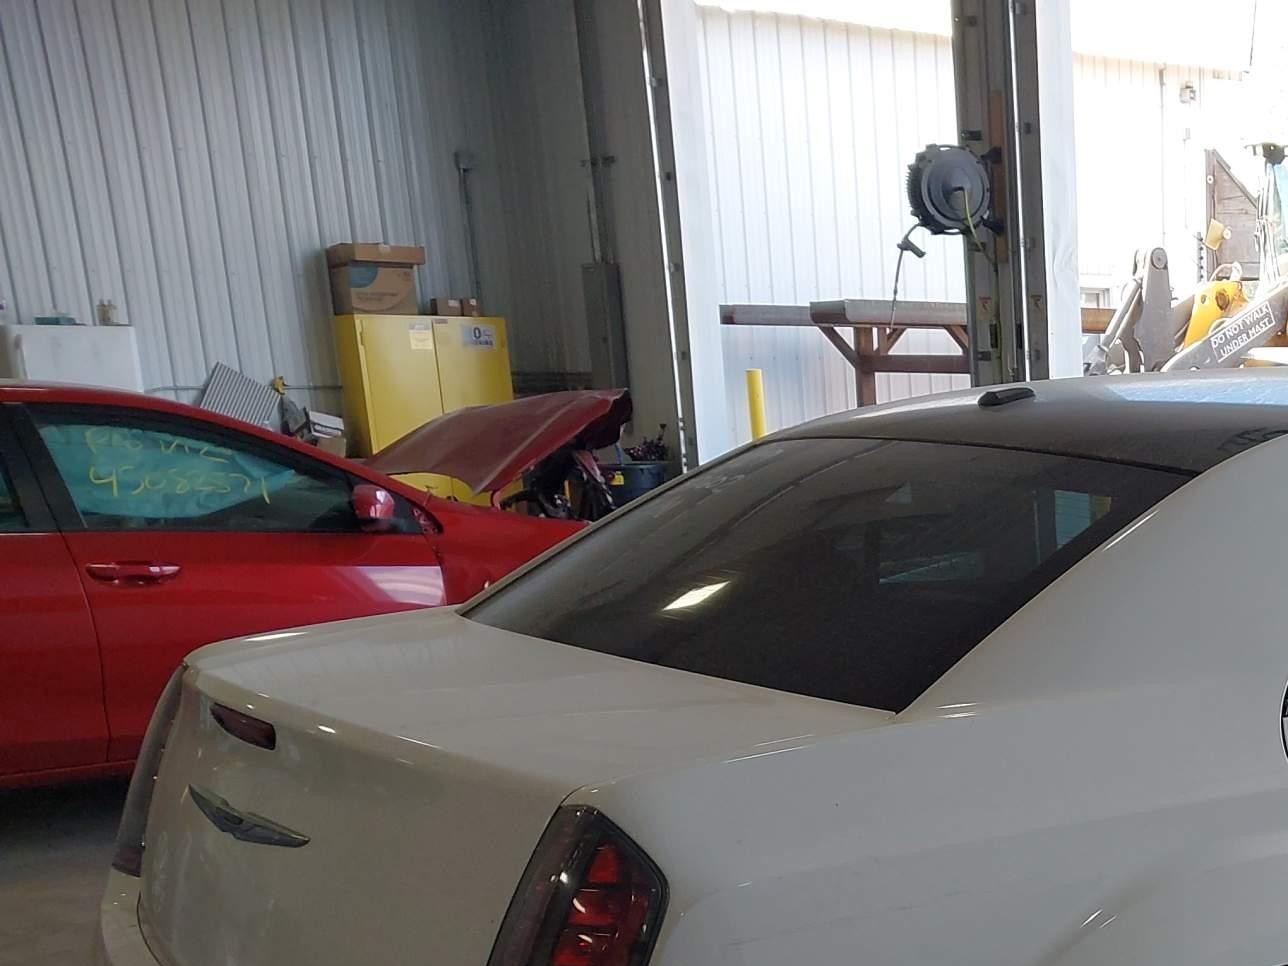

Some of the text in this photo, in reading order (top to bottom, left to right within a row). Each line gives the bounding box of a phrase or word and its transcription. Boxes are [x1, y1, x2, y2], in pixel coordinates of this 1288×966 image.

[1211, 304, 1270, 348] DO NOT WALK
[1220, 318, 1270, 357] UNDER MAST
